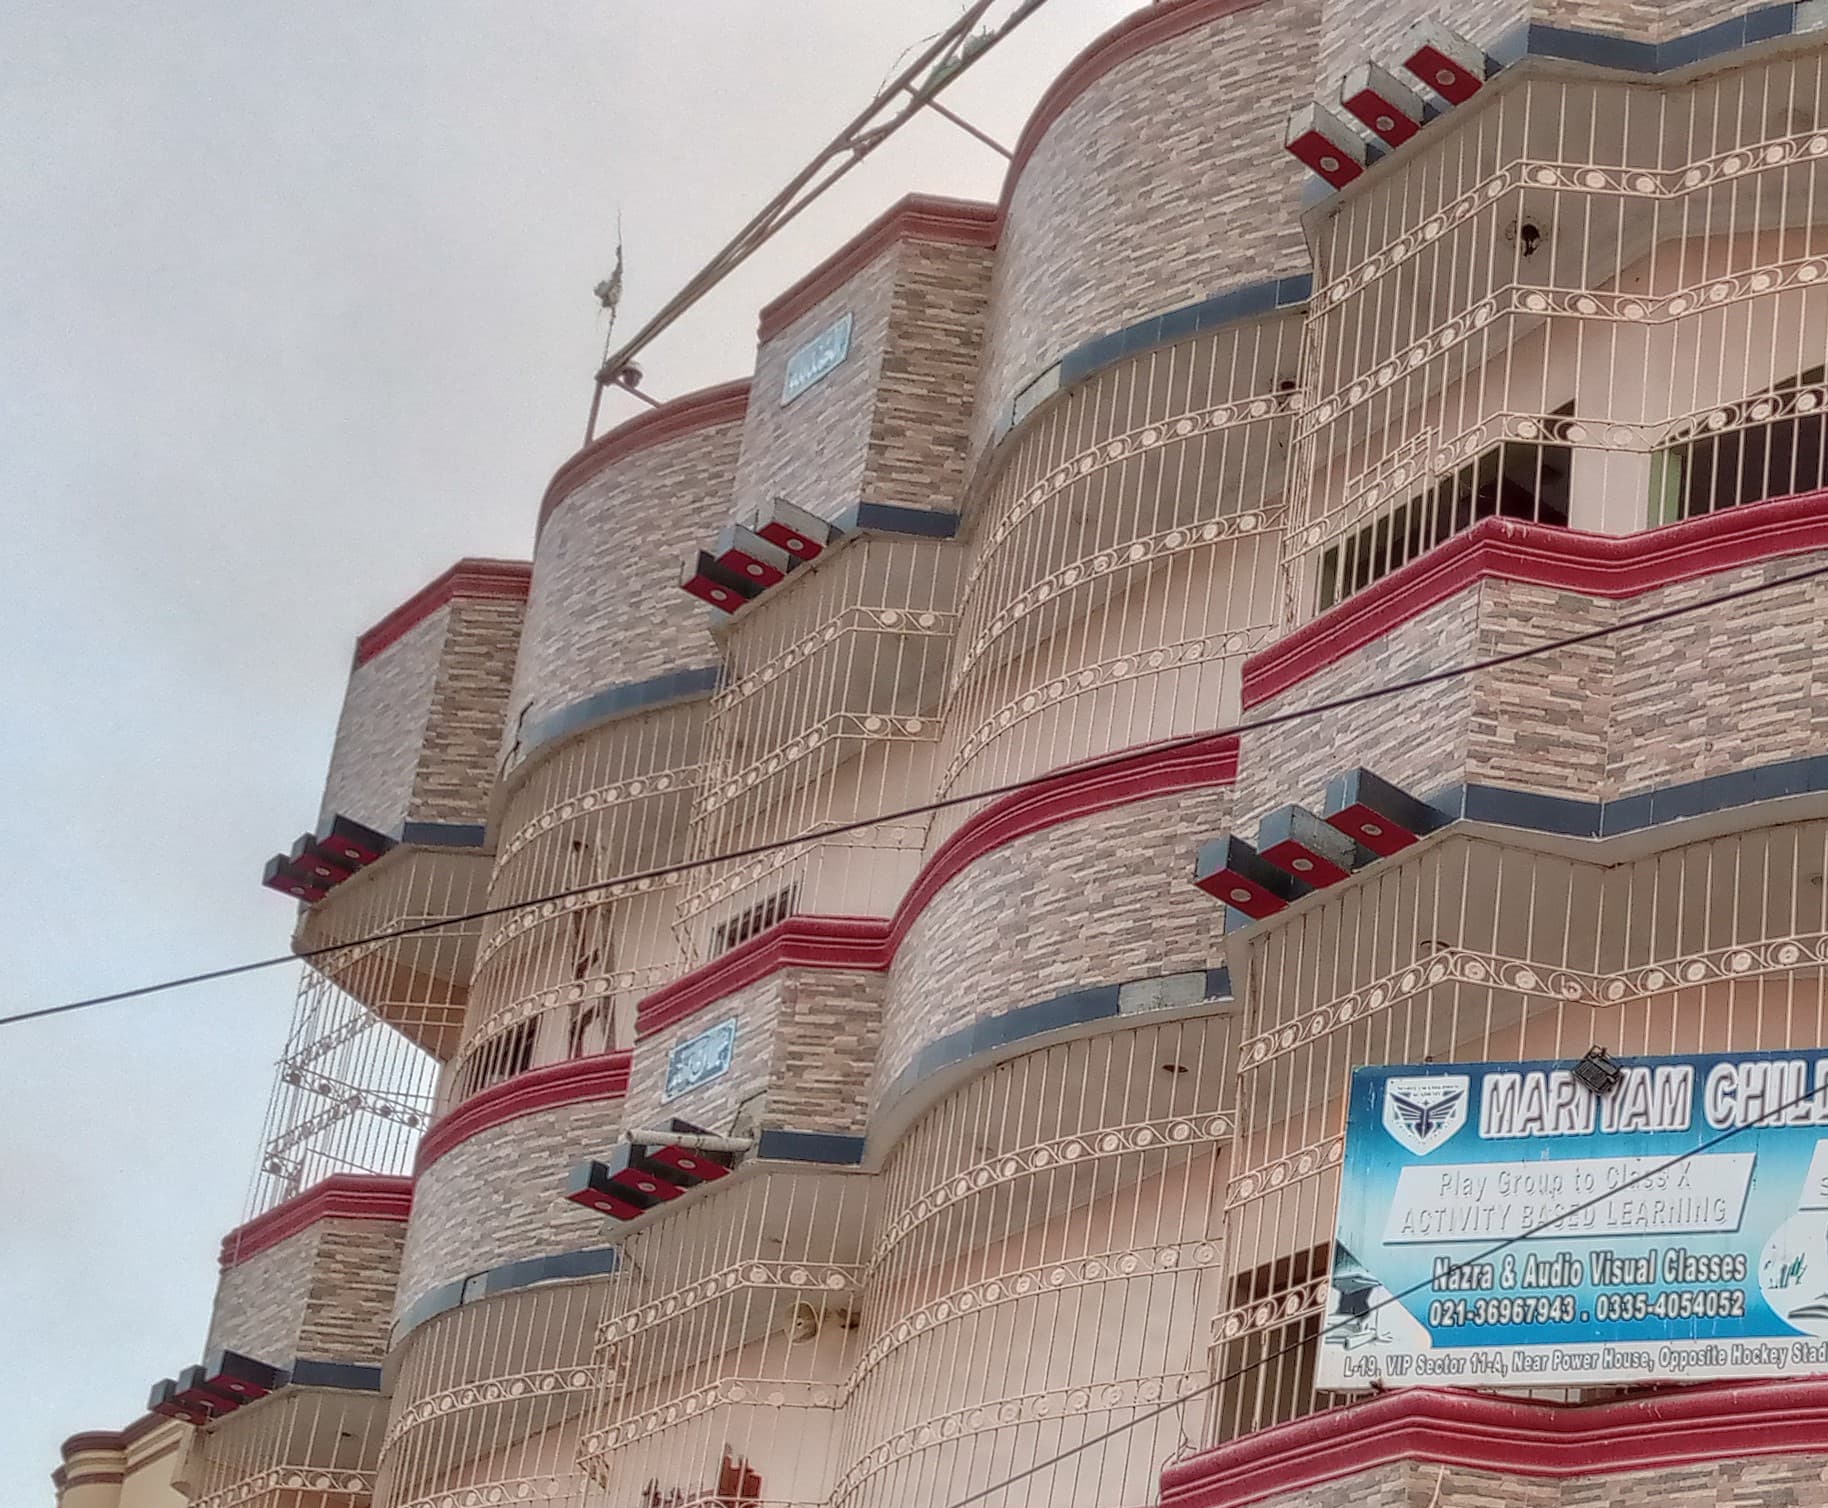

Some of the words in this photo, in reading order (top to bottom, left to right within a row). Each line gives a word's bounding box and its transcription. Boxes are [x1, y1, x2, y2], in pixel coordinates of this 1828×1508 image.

[1439, 1171, 1487, 1203] Play
[1498, 1167, 1563, 1200] Group
[1575, 1166, 1595, 1191] to
[1677, 1160, 1693, 1188] X
[1401, 1203, 1513, 1234] ACTIVITY
[1520, 1200, 1594, 1230] BASED
[1606, 1197, 1728, 1227] LEARNING
[1432, 1256, 1493, 1292] Nazra
[1499, 1256, 1517, 1290] &
[1522, 1253, 1582, 1289] Audio
[1590, 1250, 1657, 1287] Visual
[1663, 1247, 1747, 1283] Classes
[1429, 1298, 1575, 1328] 021-36967943
[1596, 1290, 1745, 1322] 0335-4054052
[1386, 1354, 1412, 1376] VIP
[1415, 1353, 1465, 1375] Sector
[1512, 1351, 1550, 1373] Near
[1552, 1349, 1599, 1372] Power
[1602, 1348, 1656, 1373] House,
[1658, 1347, 1727, 1371] Opposite
[1729, 1344, 1789, 1368] Hockey
